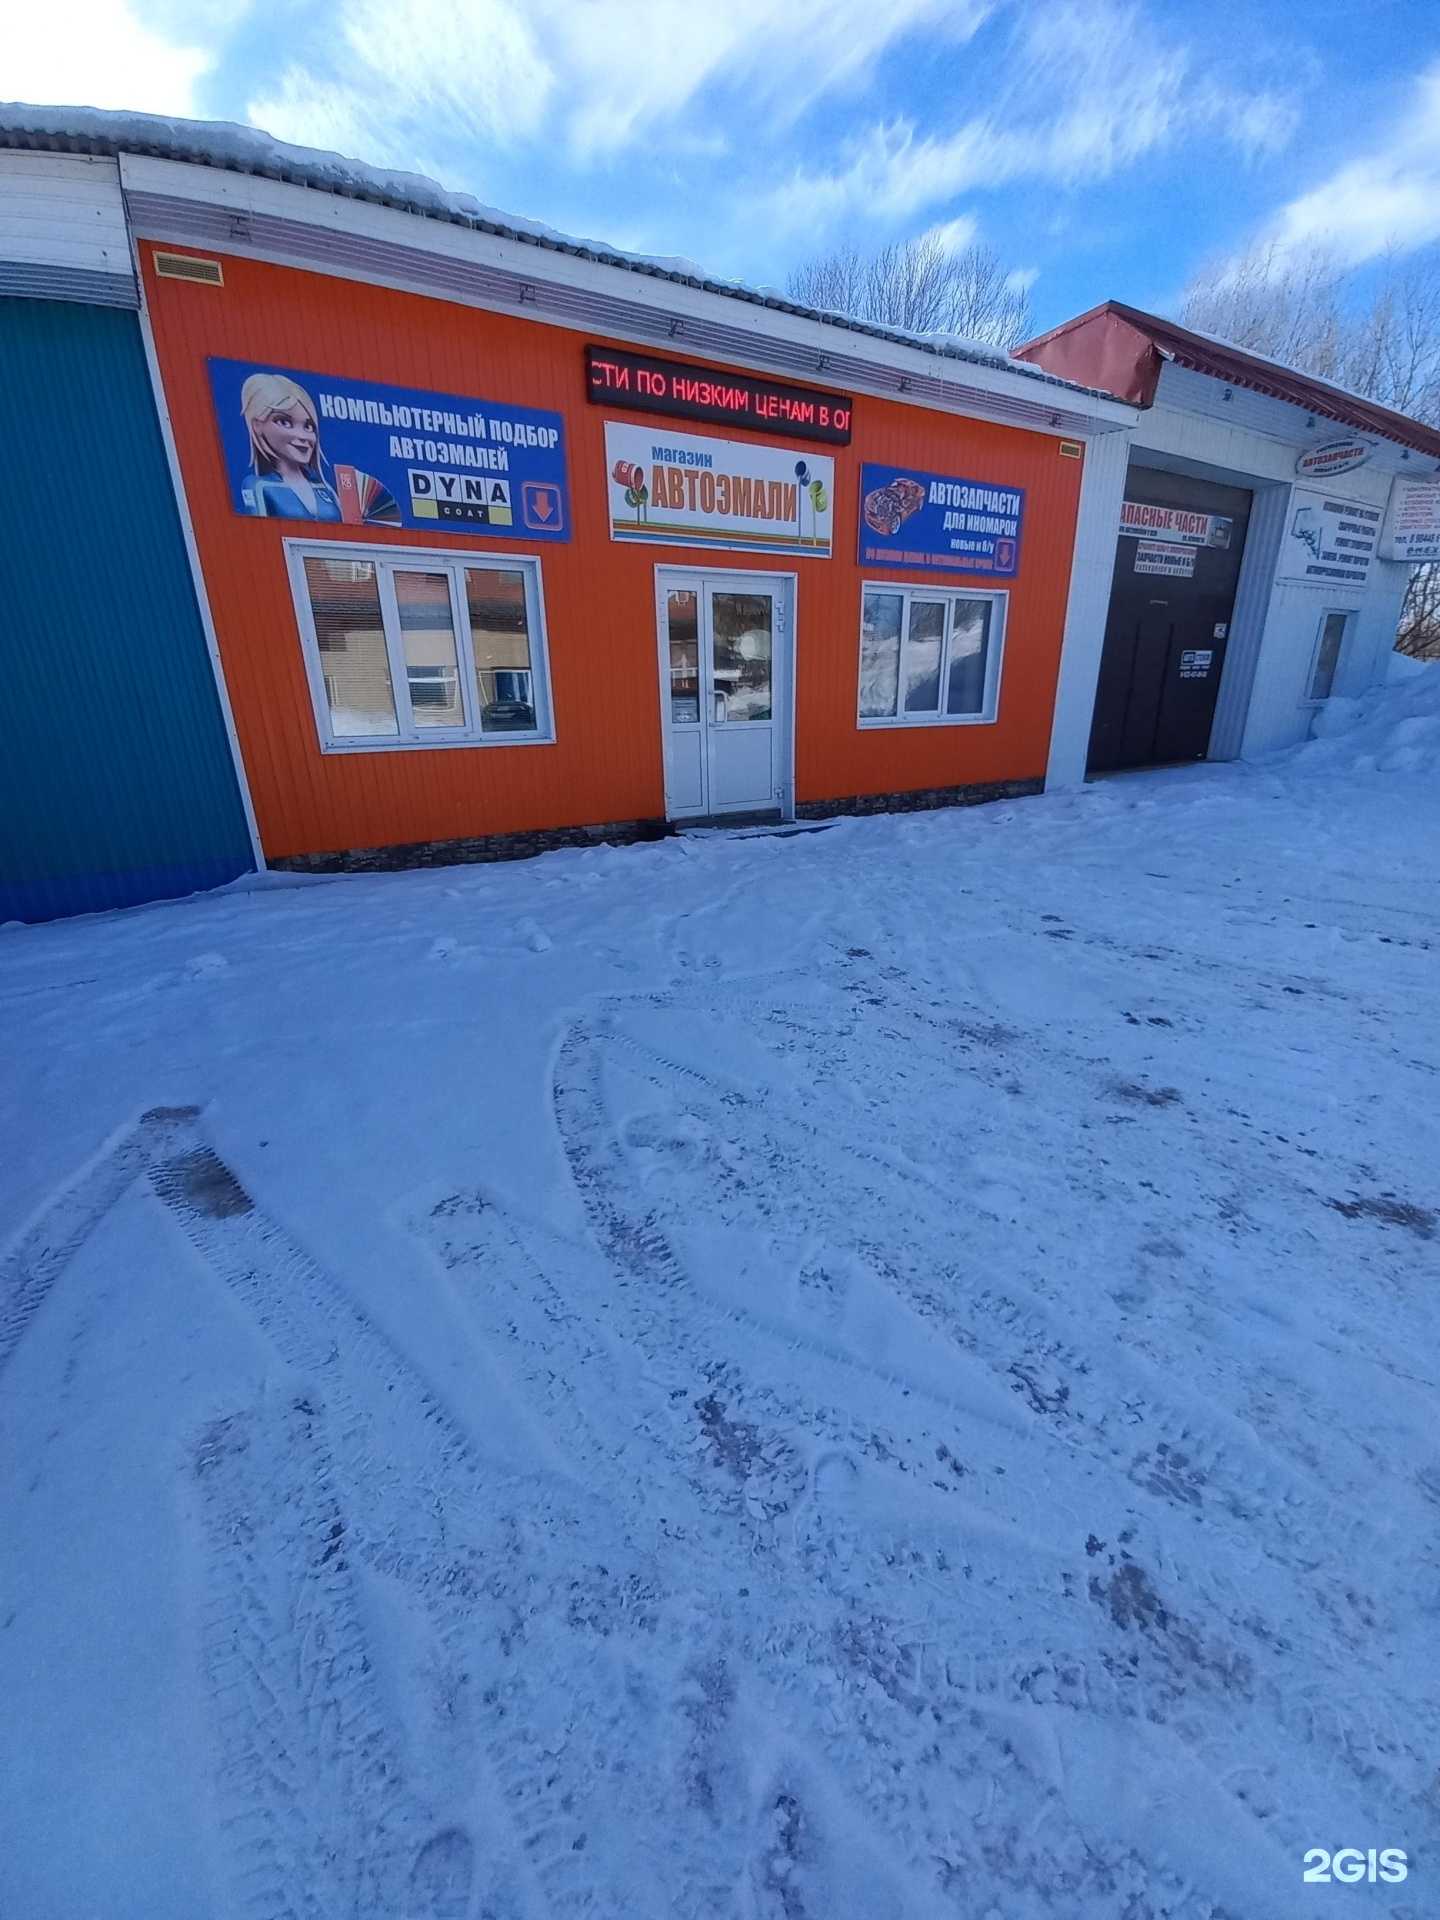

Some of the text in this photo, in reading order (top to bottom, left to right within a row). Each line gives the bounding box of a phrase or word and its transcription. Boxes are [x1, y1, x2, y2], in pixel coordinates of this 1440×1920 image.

[637, 369, 666, 396] ПО
[672, 377, 748, 412] НИЗКИМ
[755, 393, 813, 424] ЦЕНАМ
[819, 406, 829, 427] В
[319, 393, 559, 449] КОМПЬЮТЕРНЫЙ ПОДБОР
[389, 435, 510, 472] АВТОЭМАЛЕЙ
[652, 446, 713, 468] магазин
[413, 471, 508, 505] DYNA
[651, 464, 797, 523] АВТОЭМАЛИ
[928, 481, 1020, 516] АВТОЗАПЧАСТИ
[943, 511, 1018, 537] ДЛЯ ИНОМАРОК
[1176, 511, 1208, 535] ЧАСТИ
